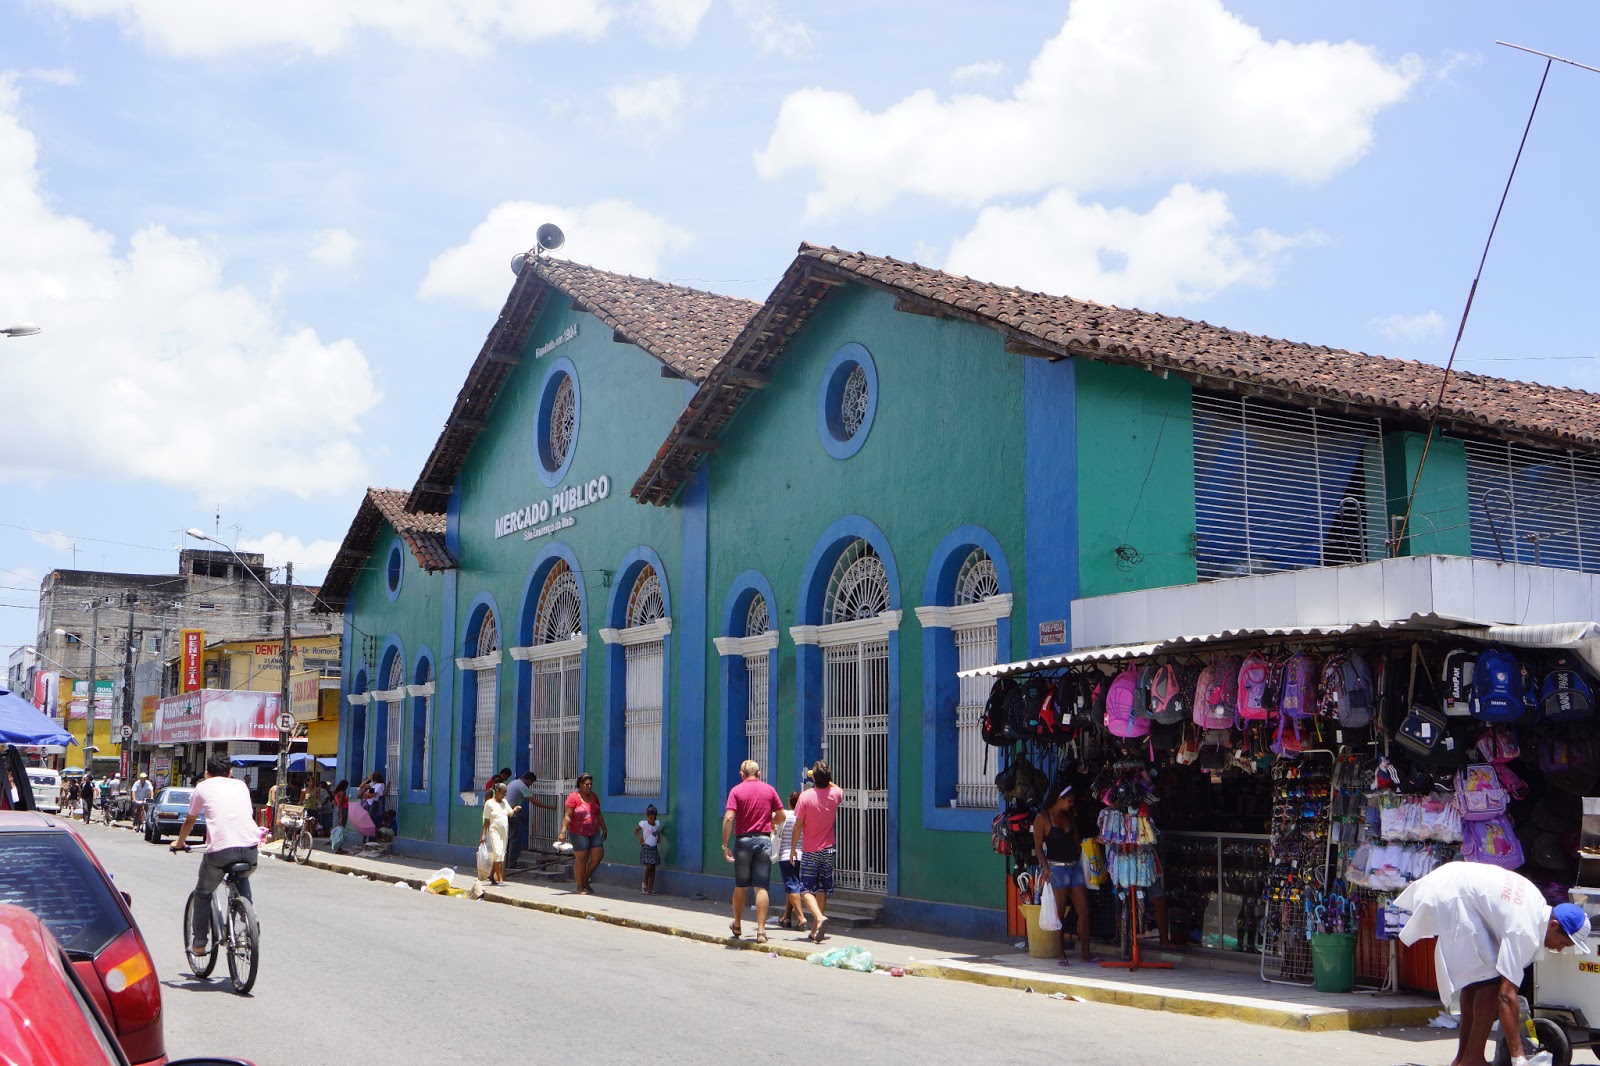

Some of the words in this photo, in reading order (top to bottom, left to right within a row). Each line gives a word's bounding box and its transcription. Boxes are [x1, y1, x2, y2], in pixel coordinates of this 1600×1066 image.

[495, 500, 549, 539] MERCADO
[552, 475, 609, 517] PÚBLICO
[533, 521, 554, 536] Lourenço
[188, 634, 198, 685] DENTISTA
[255, 645, 298, 656] DENTIA
[1452, 667, 1460, 698] BAKPAK
[1579, 962, 1585, 971] O
